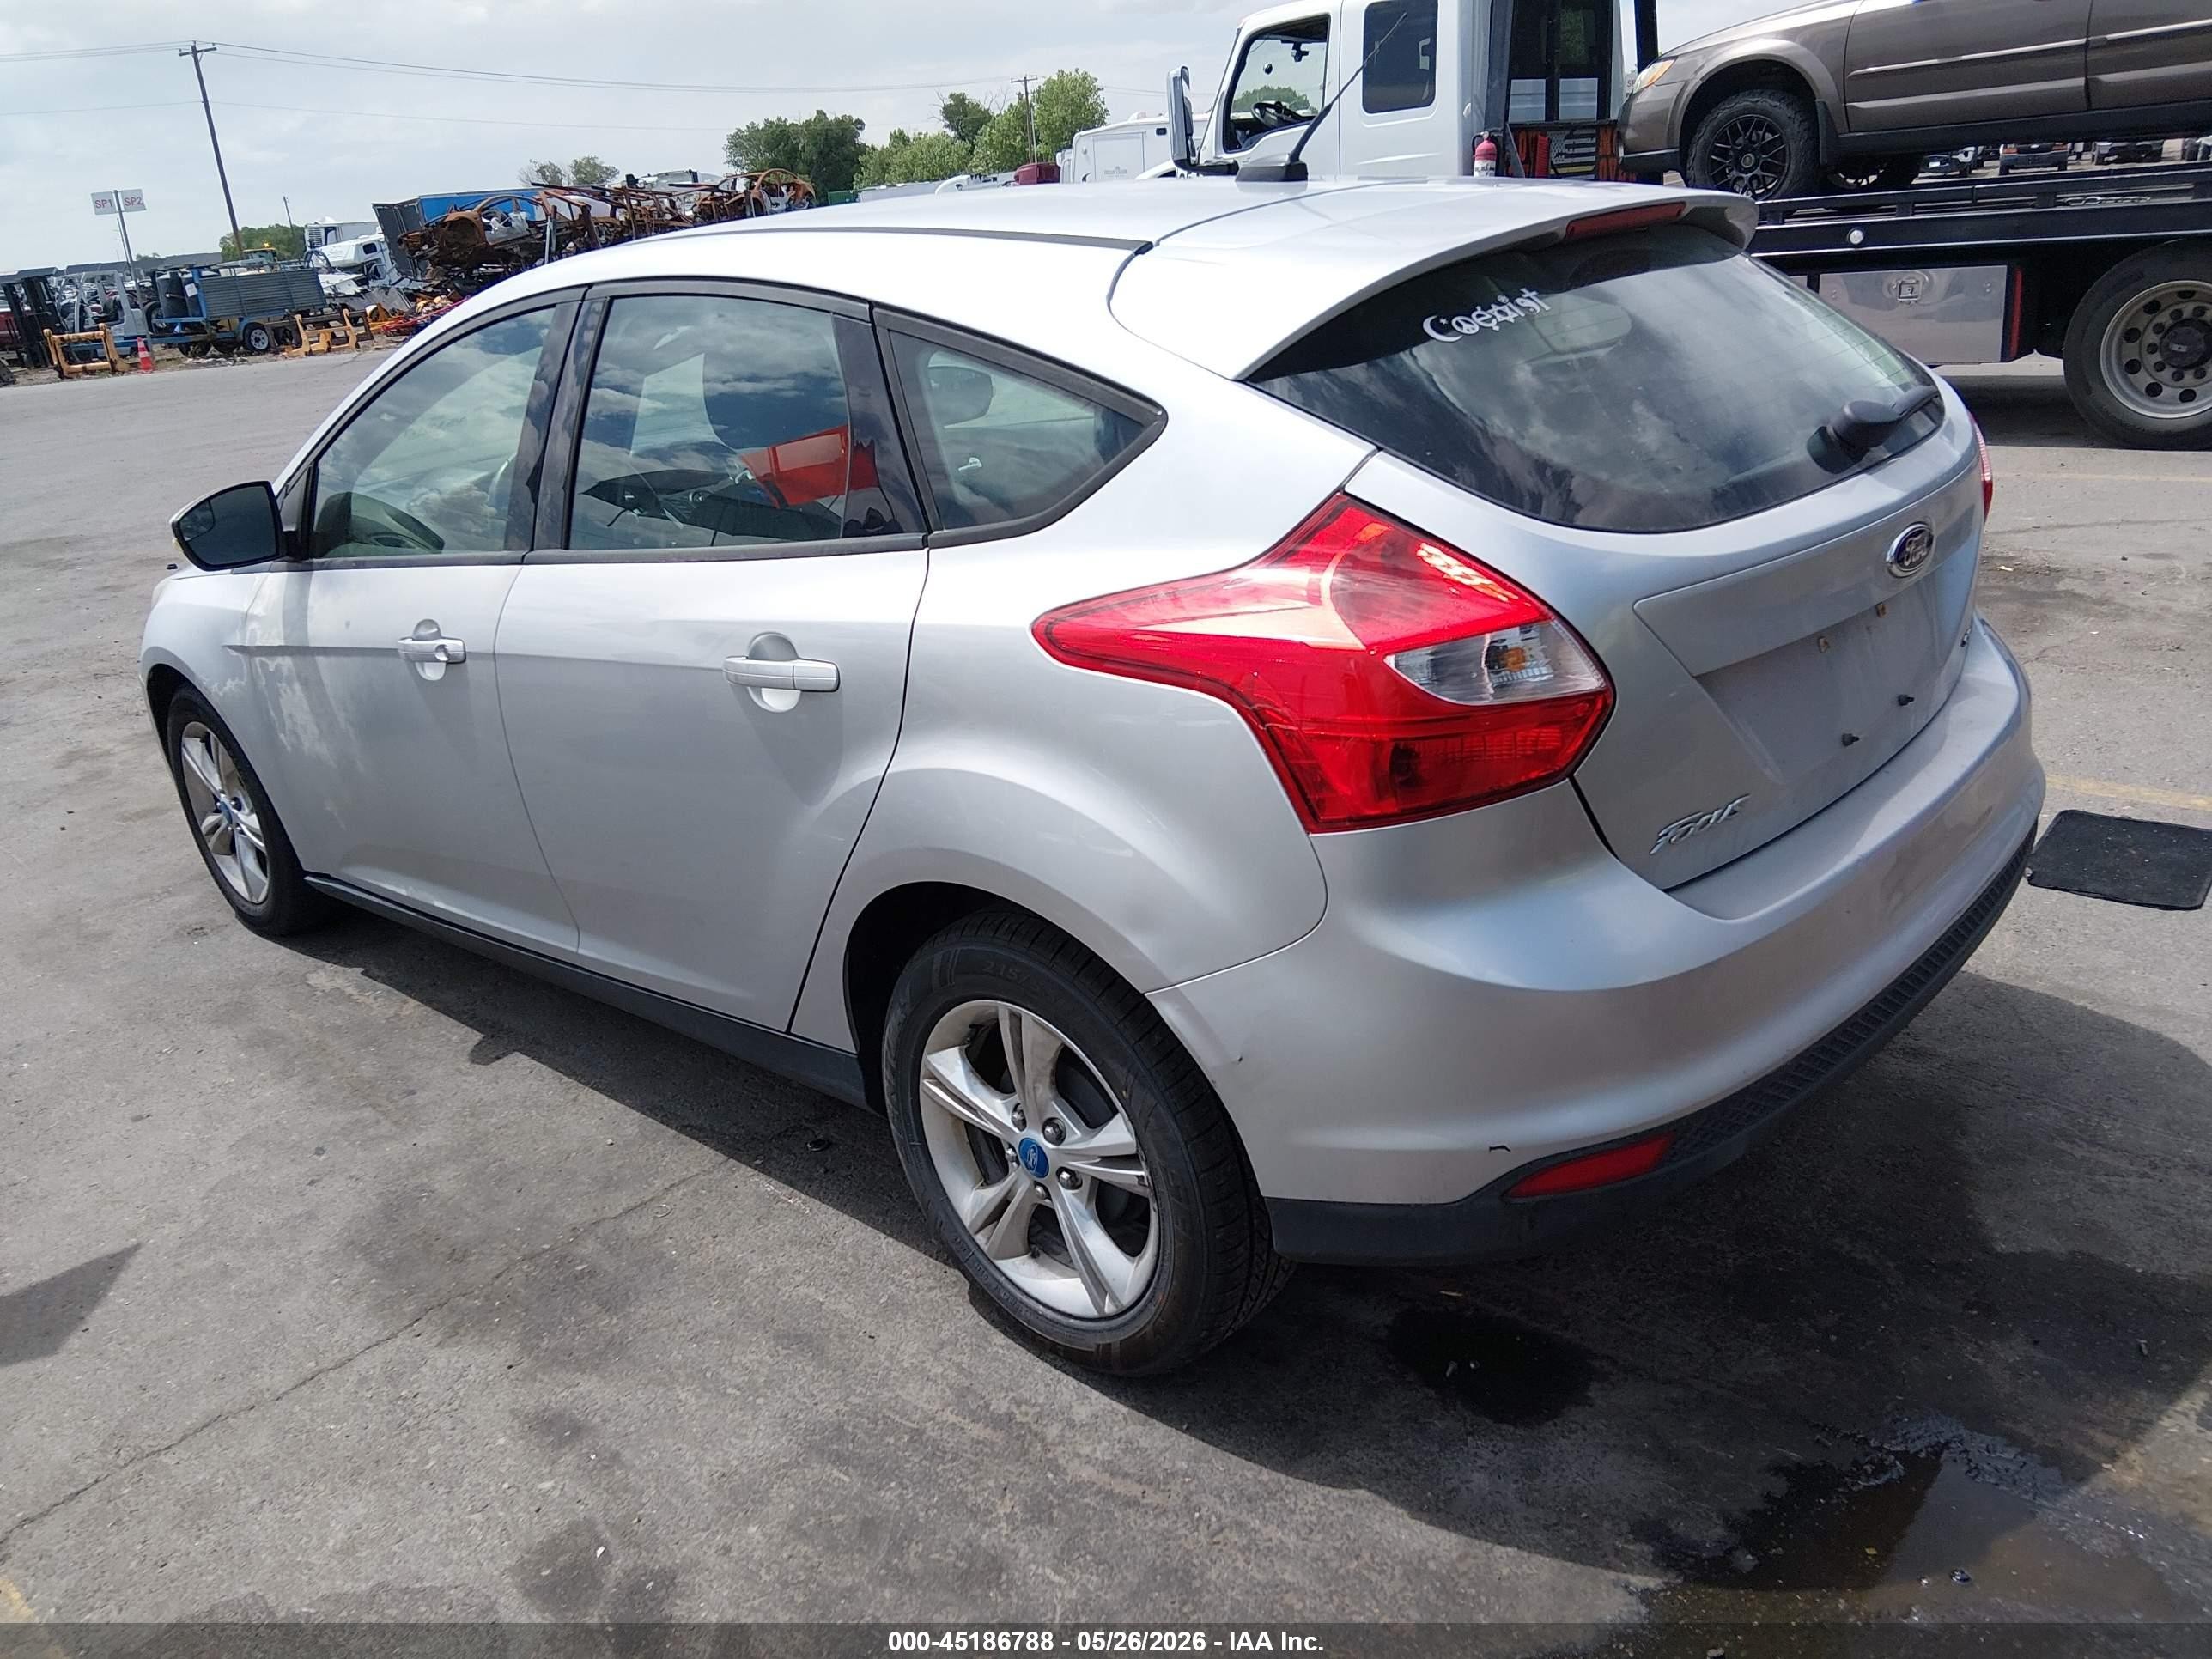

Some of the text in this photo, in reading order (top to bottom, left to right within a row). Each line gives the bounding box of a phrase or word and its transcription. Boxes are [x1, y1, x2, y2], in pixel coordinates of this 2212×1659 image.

[94, 199, 112, 209] SP1
[124, 197, 143, 206] SP2
[1422, 288, 1551, 342] Coexist
[1904, 531, 1929, 567] Ford
